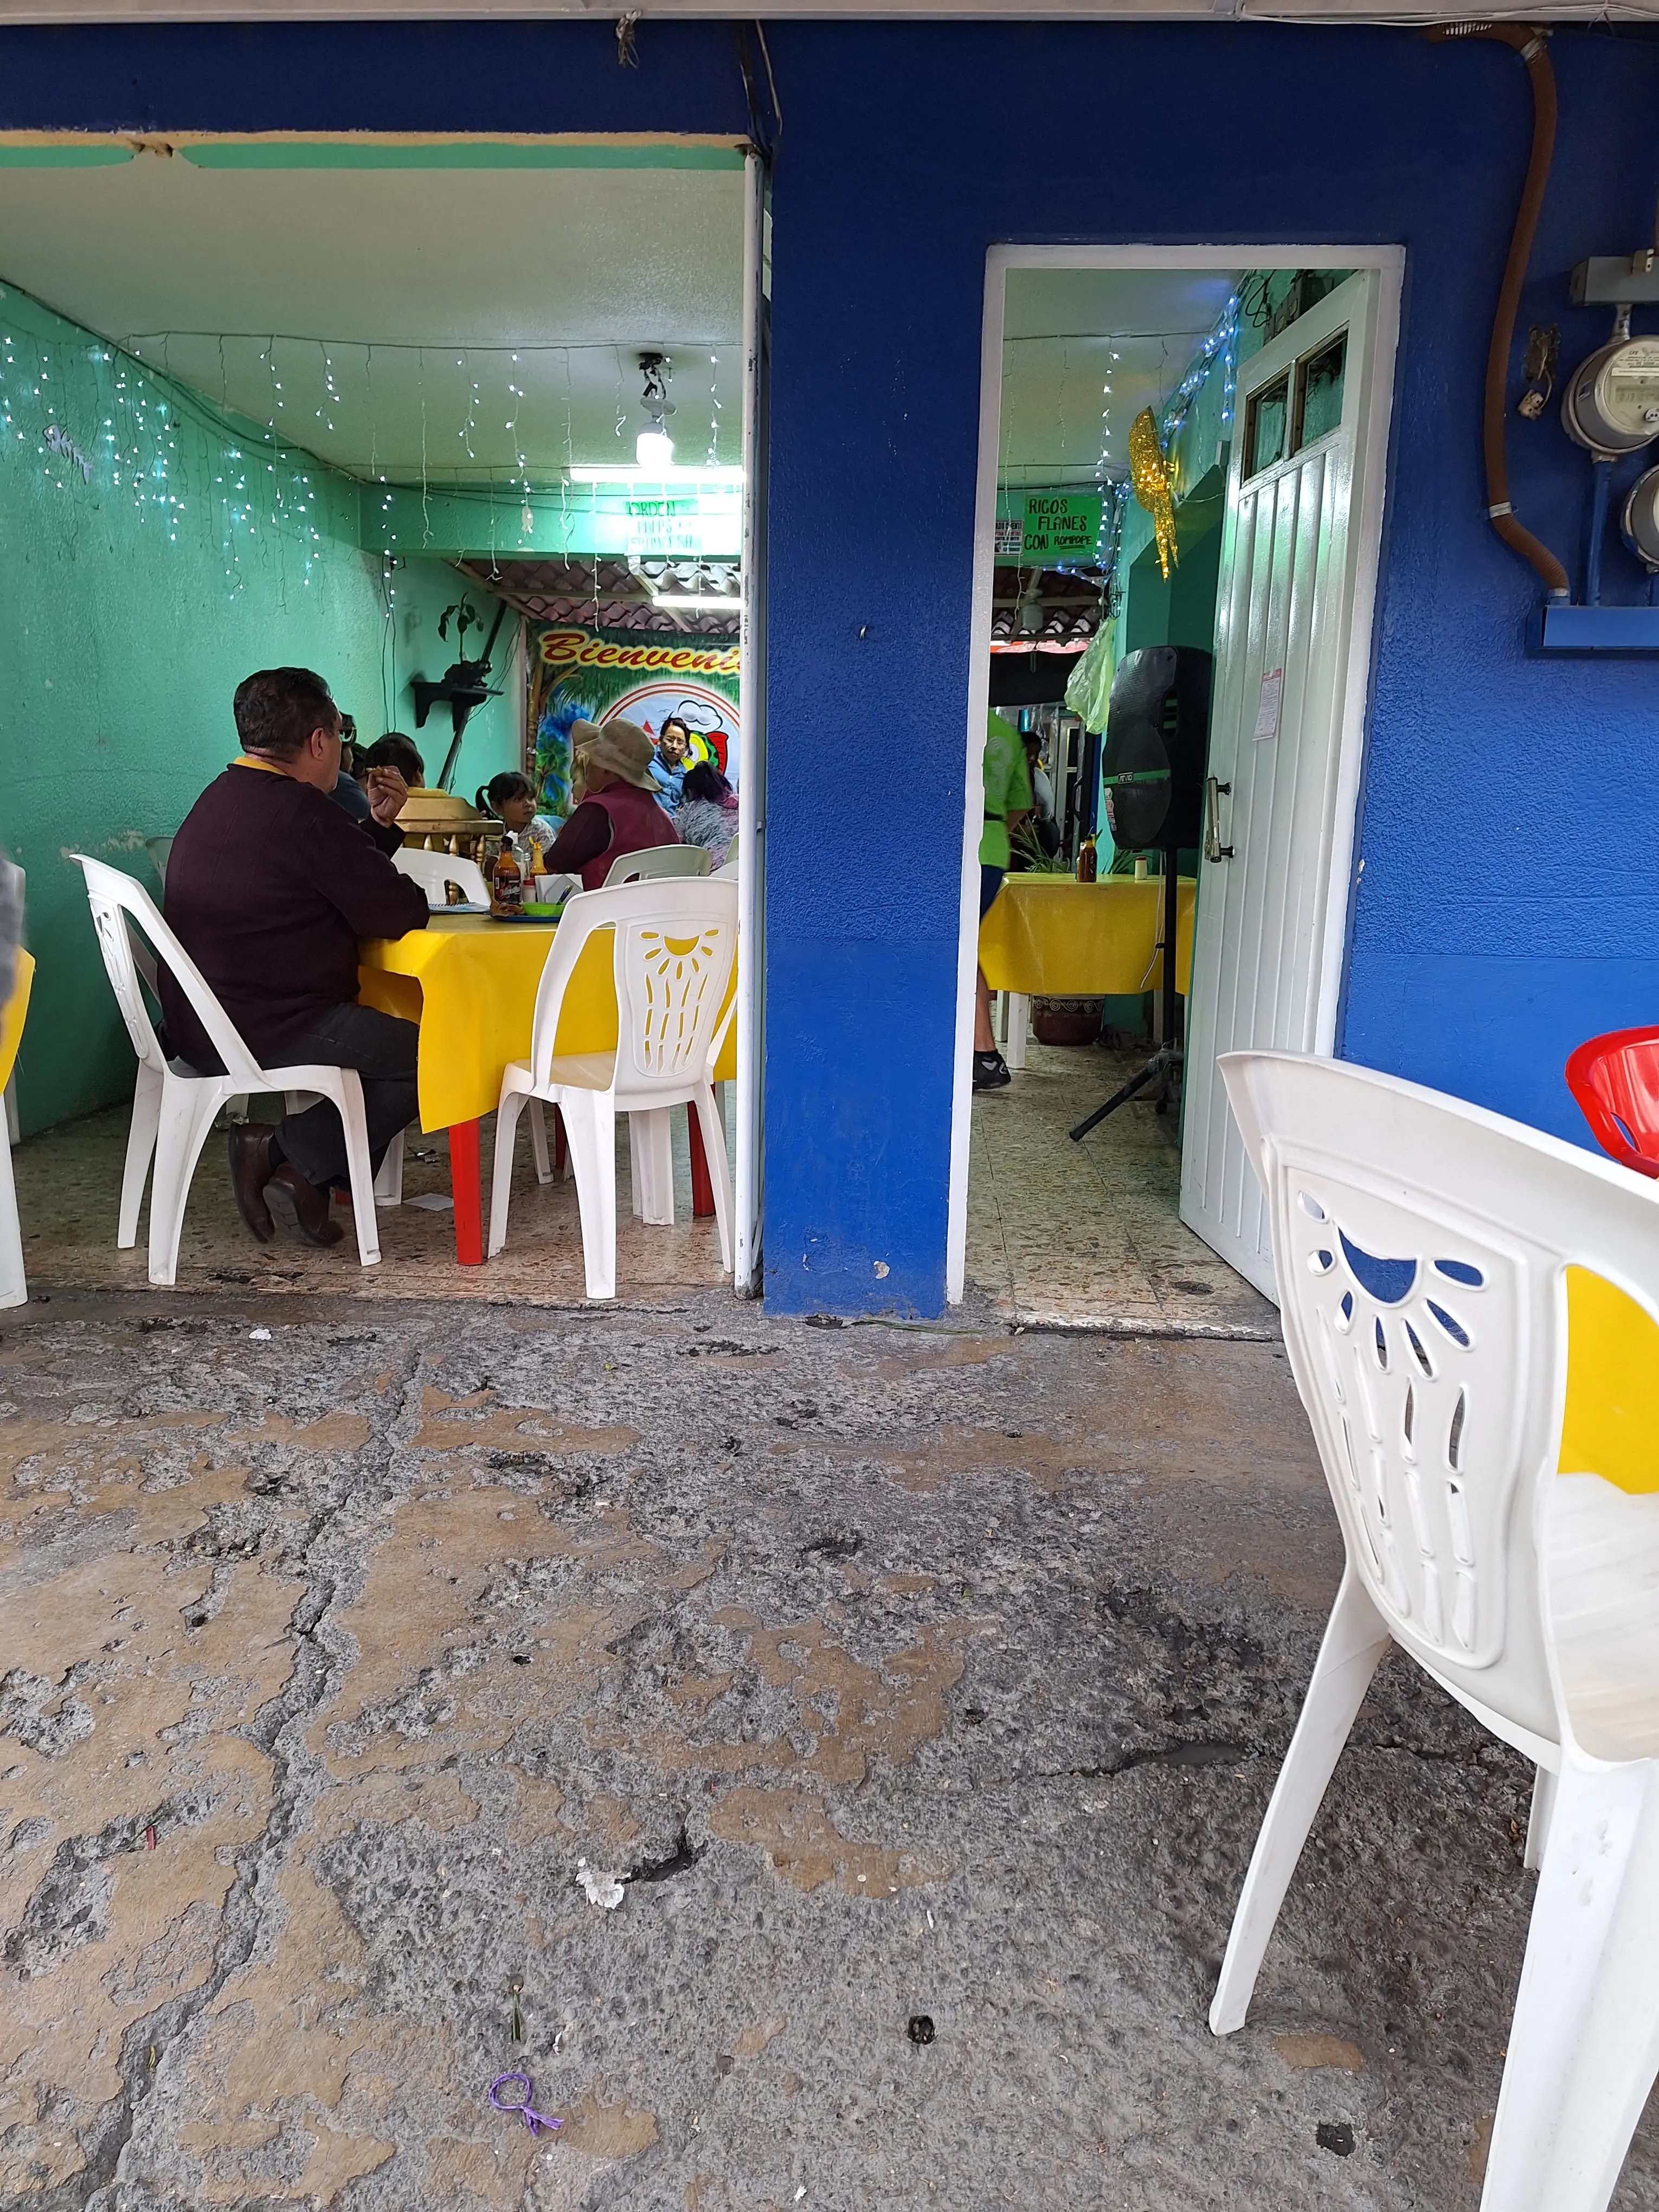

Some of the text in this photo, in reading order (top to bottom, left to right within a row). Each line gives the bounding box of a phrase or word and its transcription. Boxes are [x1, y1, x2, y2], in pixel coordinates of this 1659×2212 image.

[1028, 498, 1068, 515] RICOS
[1038, 515, 1088, 531] FLANES
[1024, 533, 1094, 551] CON ROMPOPE
[542, 633, 740, 671] Bienveni
